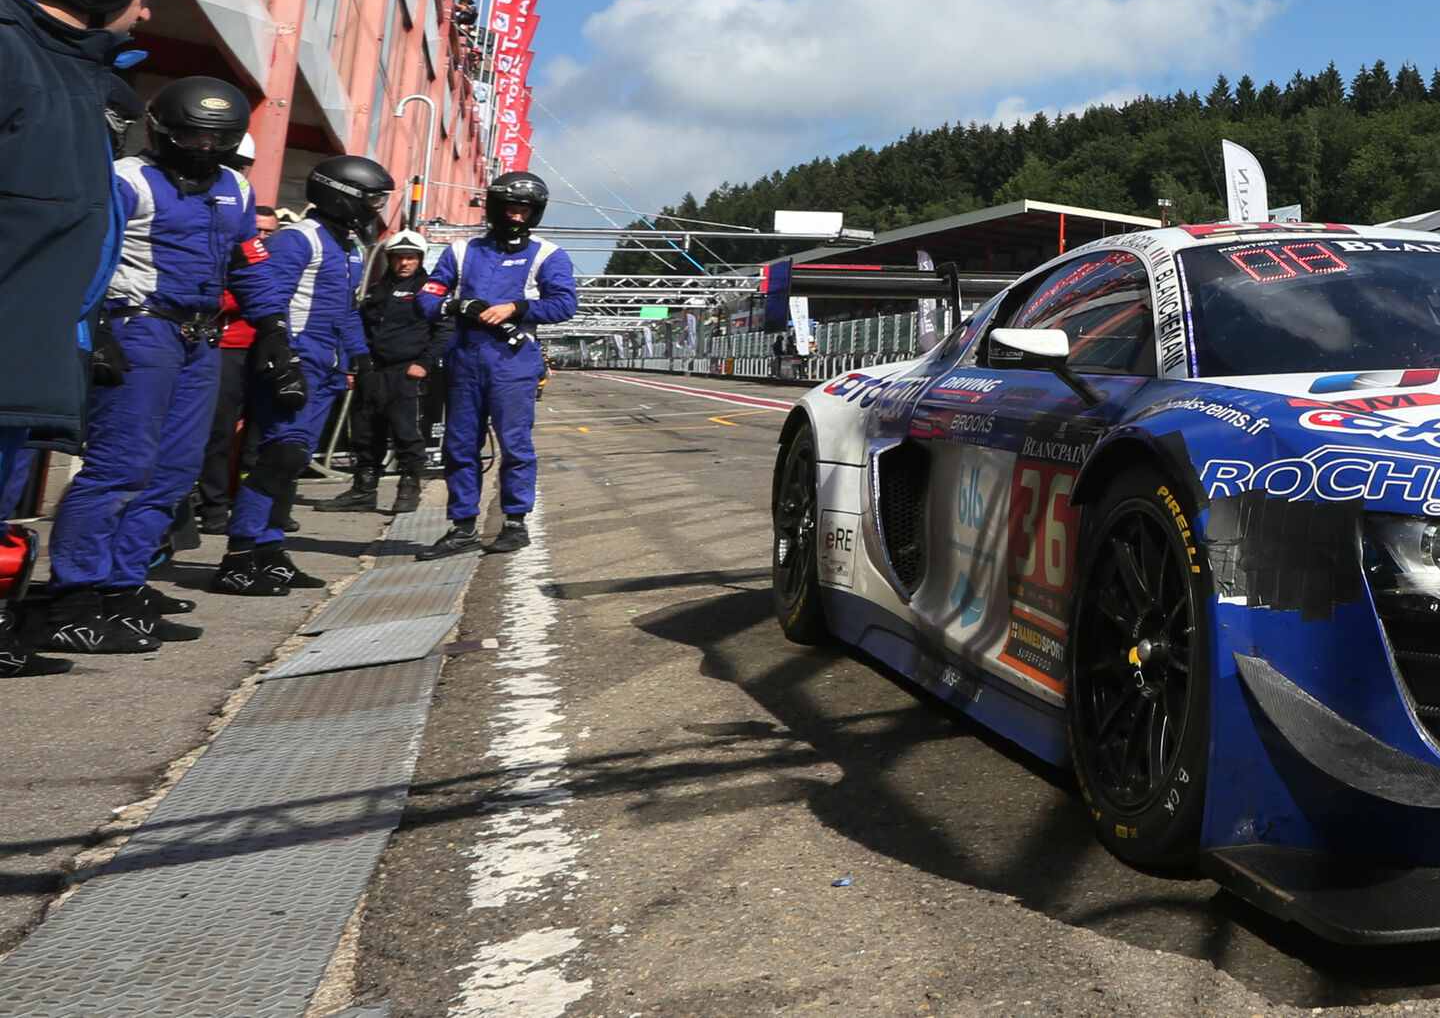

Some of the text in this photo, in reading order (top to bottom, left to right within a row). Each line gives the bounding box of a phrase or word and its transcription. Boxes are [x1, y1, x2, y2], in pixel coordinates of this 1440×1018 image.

[1217, 241, 1280, 253] POSITION
[1155, 268, 1185, 373] BLANCHEMAIN
[939, 376, 1004, 393] DRIVING
[950, 410, 997, 433] BROOKS
[1022, 436, 1091, 463] BLANCPAIN
[1015, 468, 1074, 587] 36
[1157, 485, 1200, 573] PIRELLI
